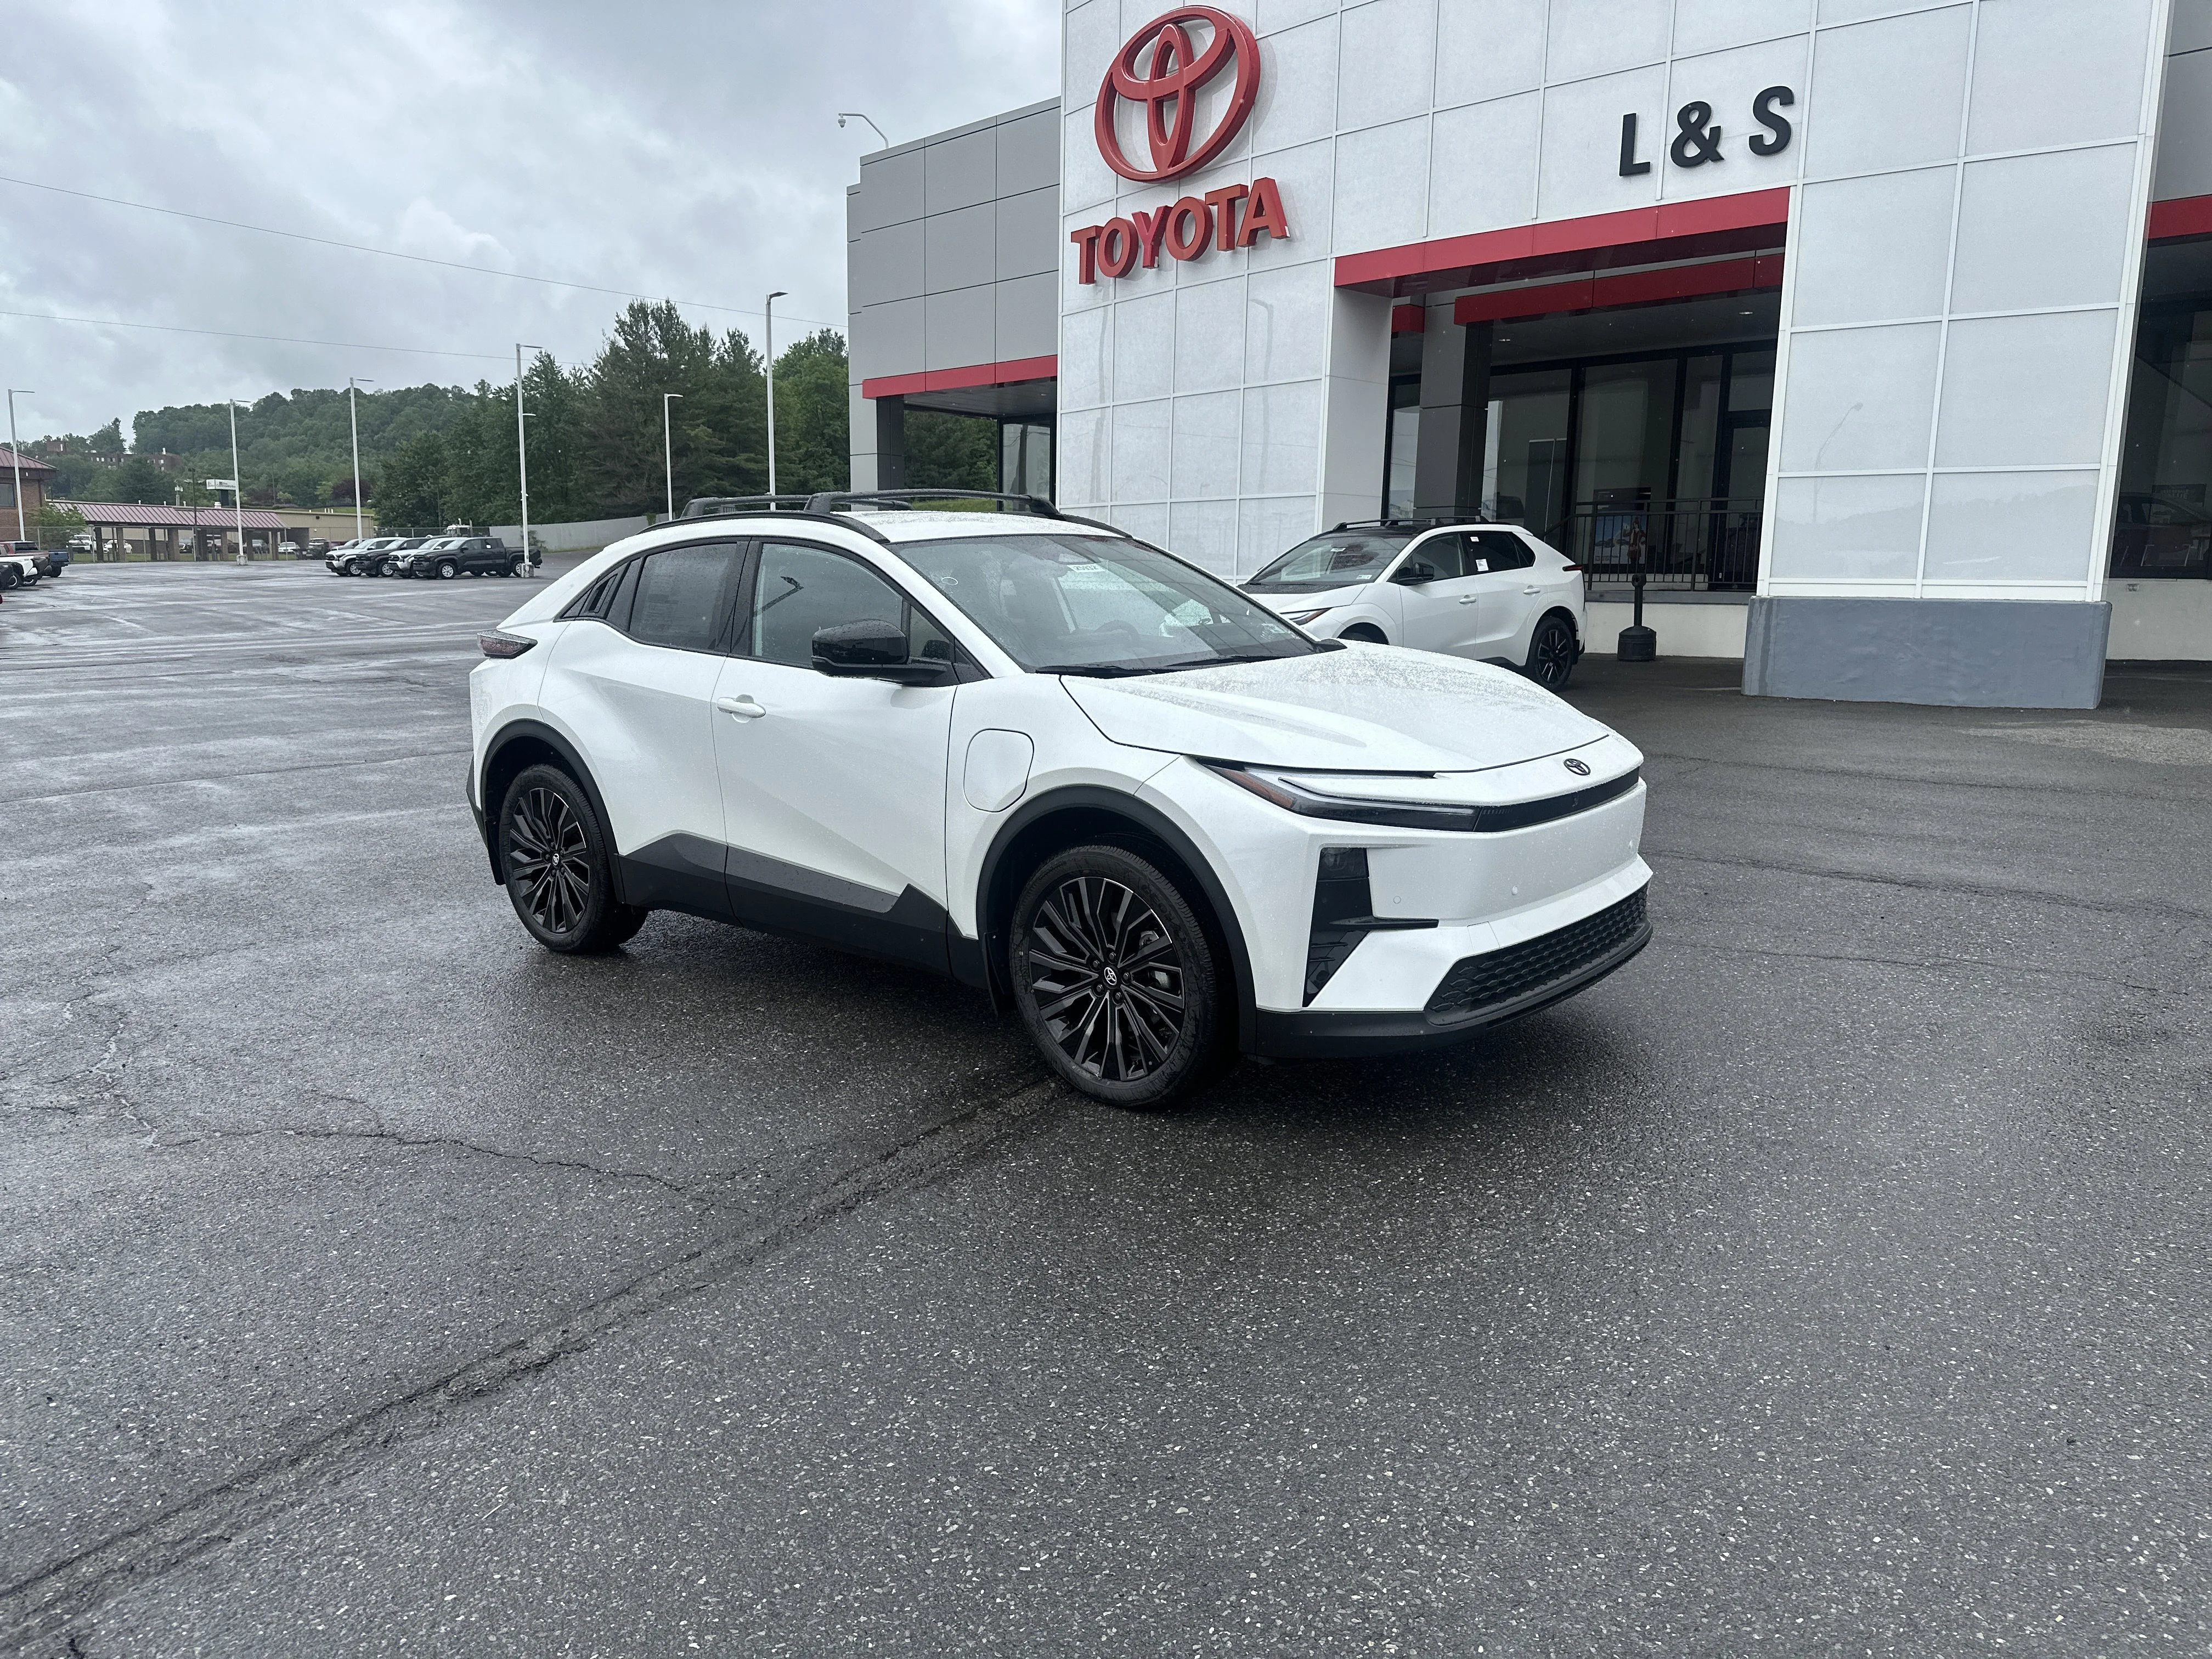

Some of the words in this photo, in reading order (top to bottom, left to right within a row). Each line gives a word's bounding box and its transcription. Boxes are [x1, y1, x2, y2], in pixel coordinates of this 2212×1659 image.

[1620, 112, 1651, 176] L
[1671, 101, 1724, 168] &
[1749, 86, 1794, 155] S
[1071, 177, 1290, 285] TOYOTA
